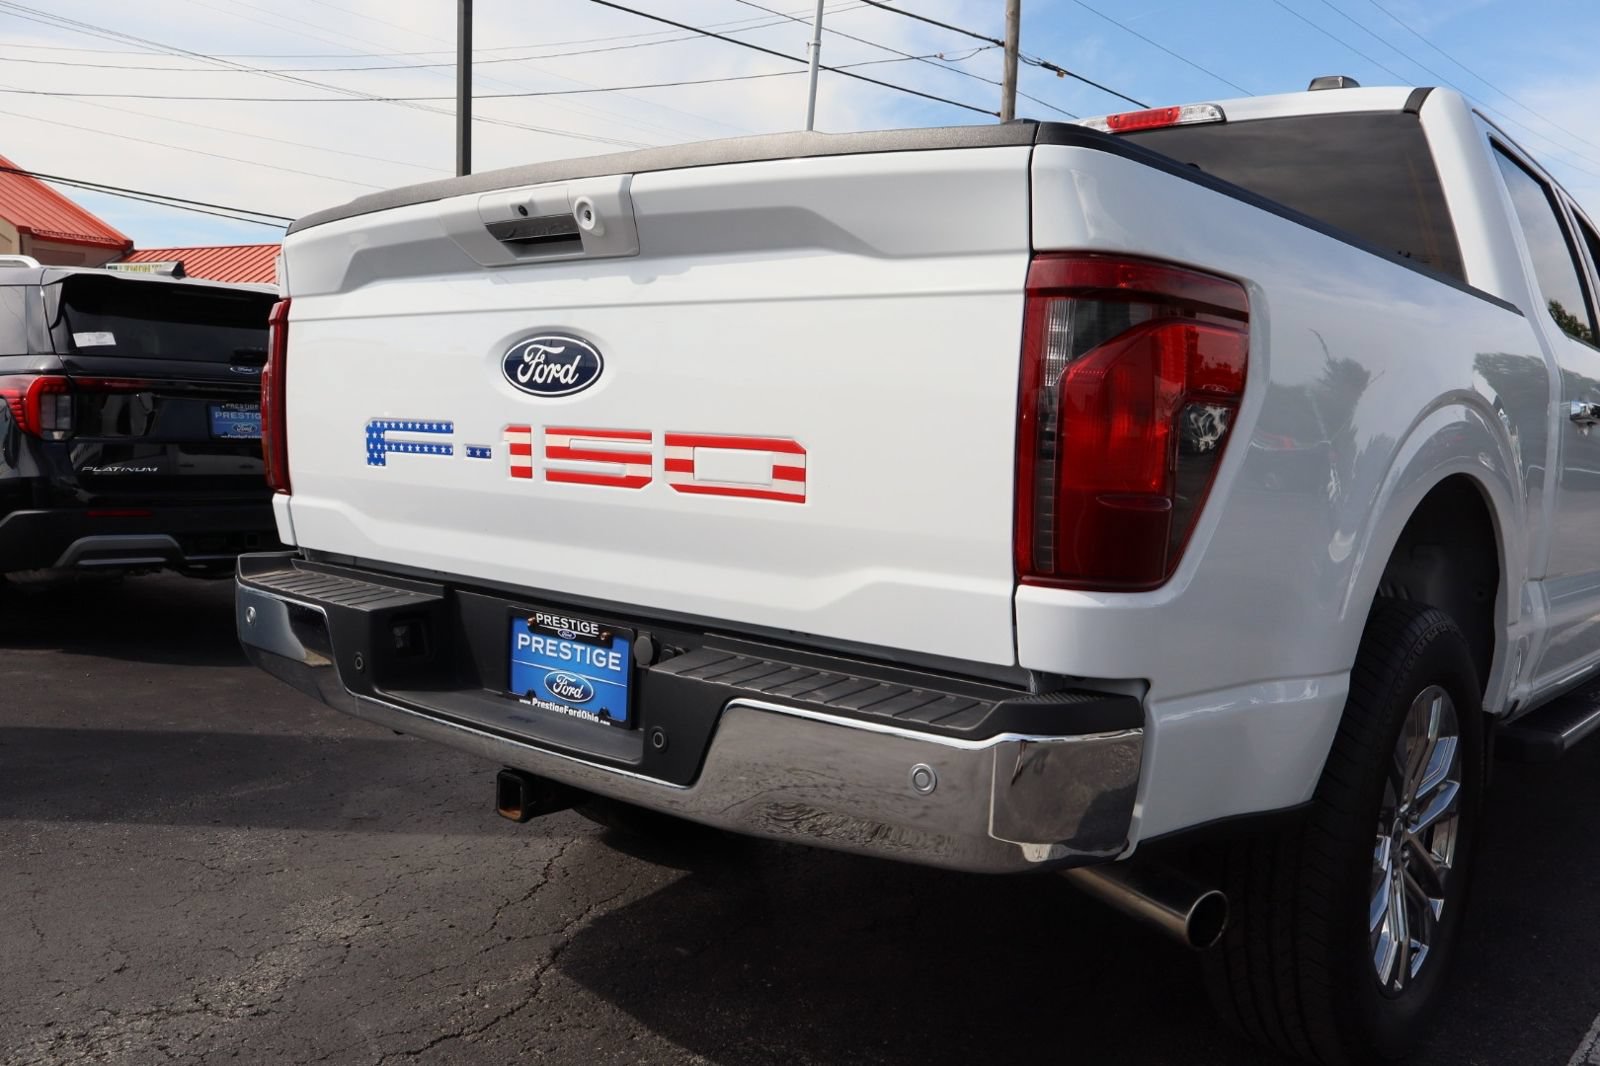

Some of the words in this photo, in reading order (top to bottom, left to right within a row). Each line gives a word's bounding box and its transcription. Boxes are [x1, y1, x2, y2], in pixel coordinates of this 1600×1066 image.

[516, 343, 580, 386] Ford
[214, 411, 262, 420] PRESTIG
[365, 417, 807, 504] F-150
[535, 613, 600, 635] PRESTIGE
[517, 633, 622, 671] PRESTIGE
[552, 673, 584, 699] Ford
